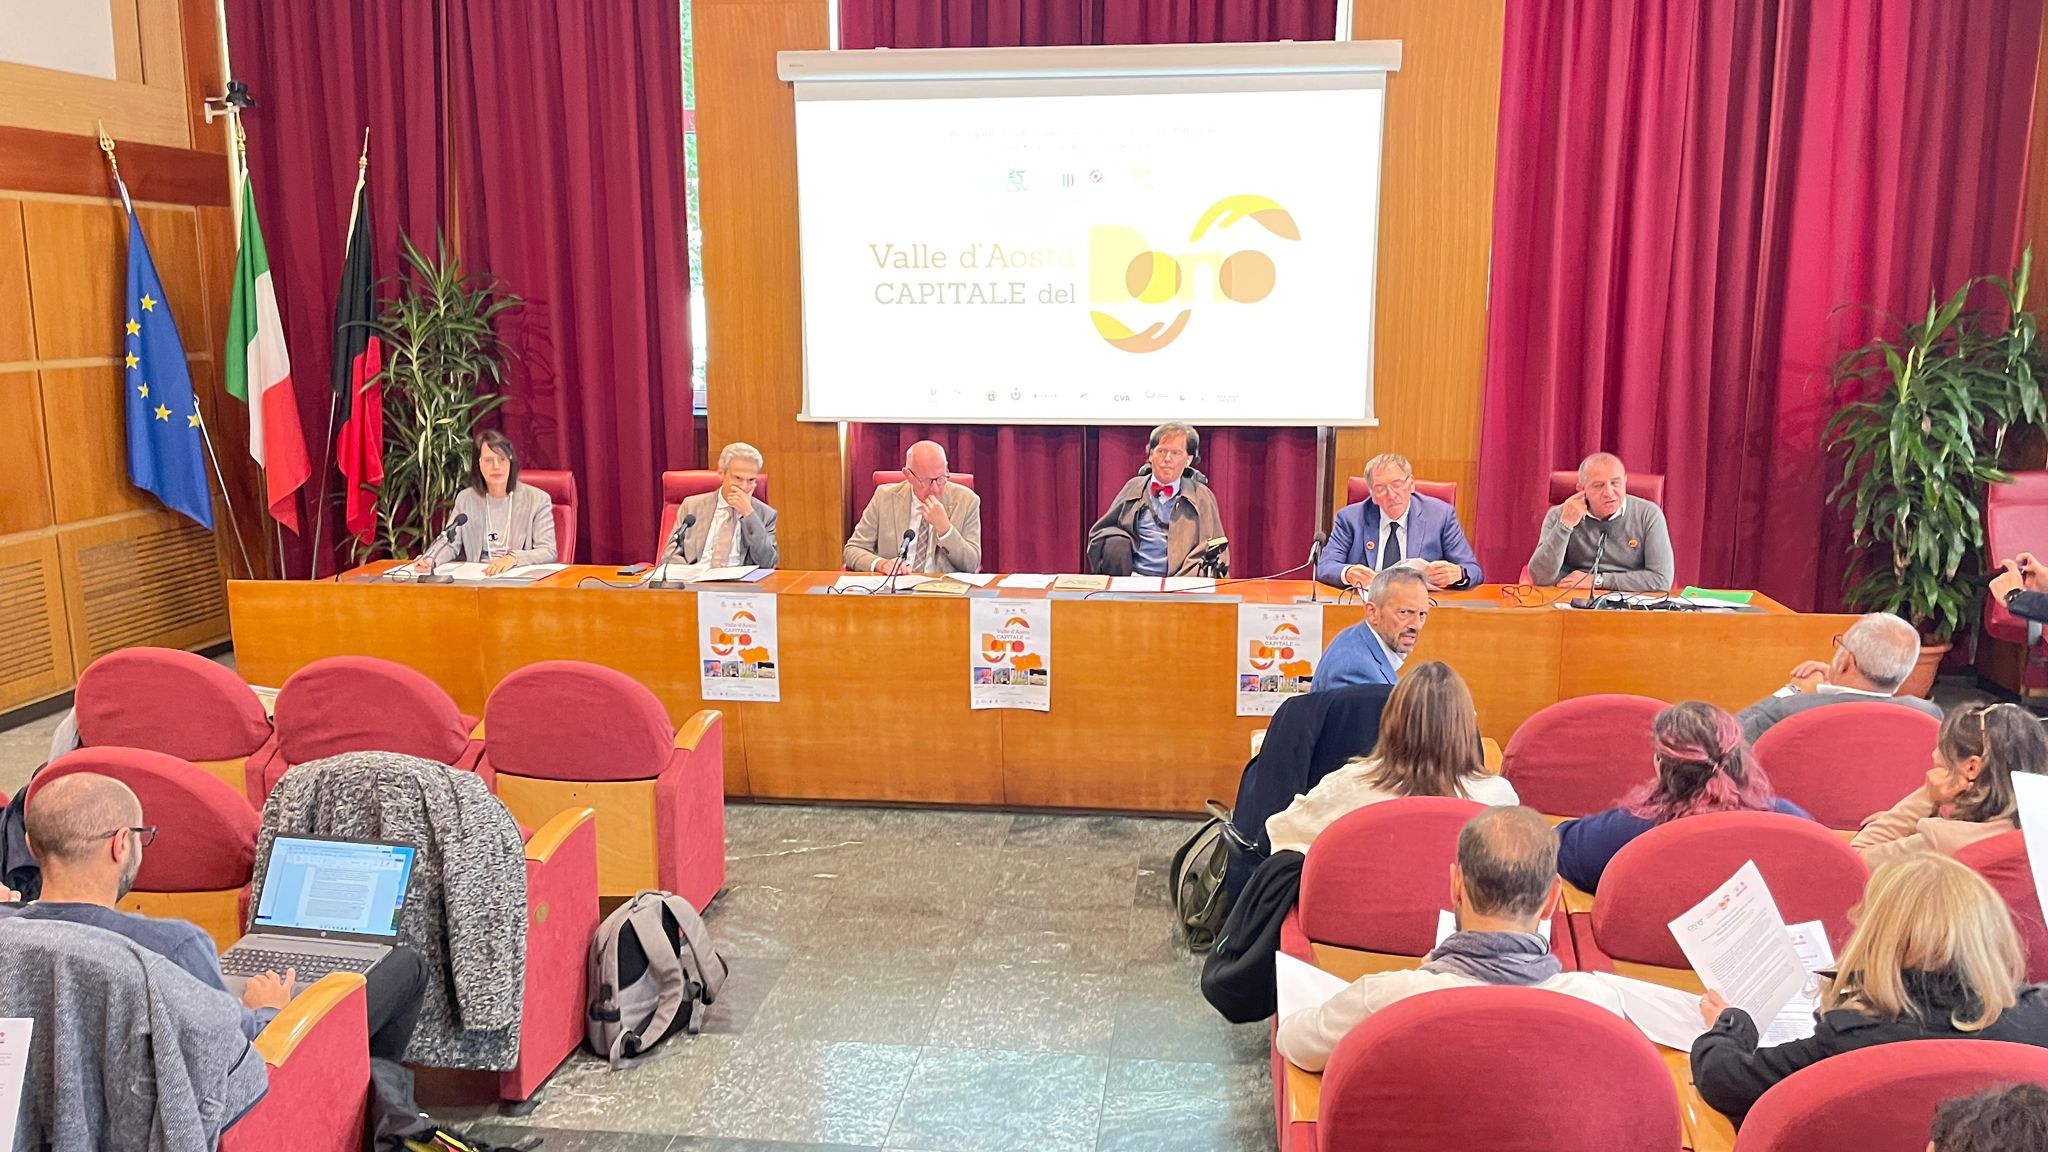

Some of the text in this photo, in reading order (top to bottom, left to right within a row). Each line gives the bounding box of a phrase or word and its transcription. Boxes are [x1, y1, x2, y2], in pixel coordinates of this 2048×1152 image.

[868, 243, 1077, 270] Valle d'Aosta
[874, 282, 1076, 305] CAPITALE del
[1113, 394, 1131, 402] CVA
